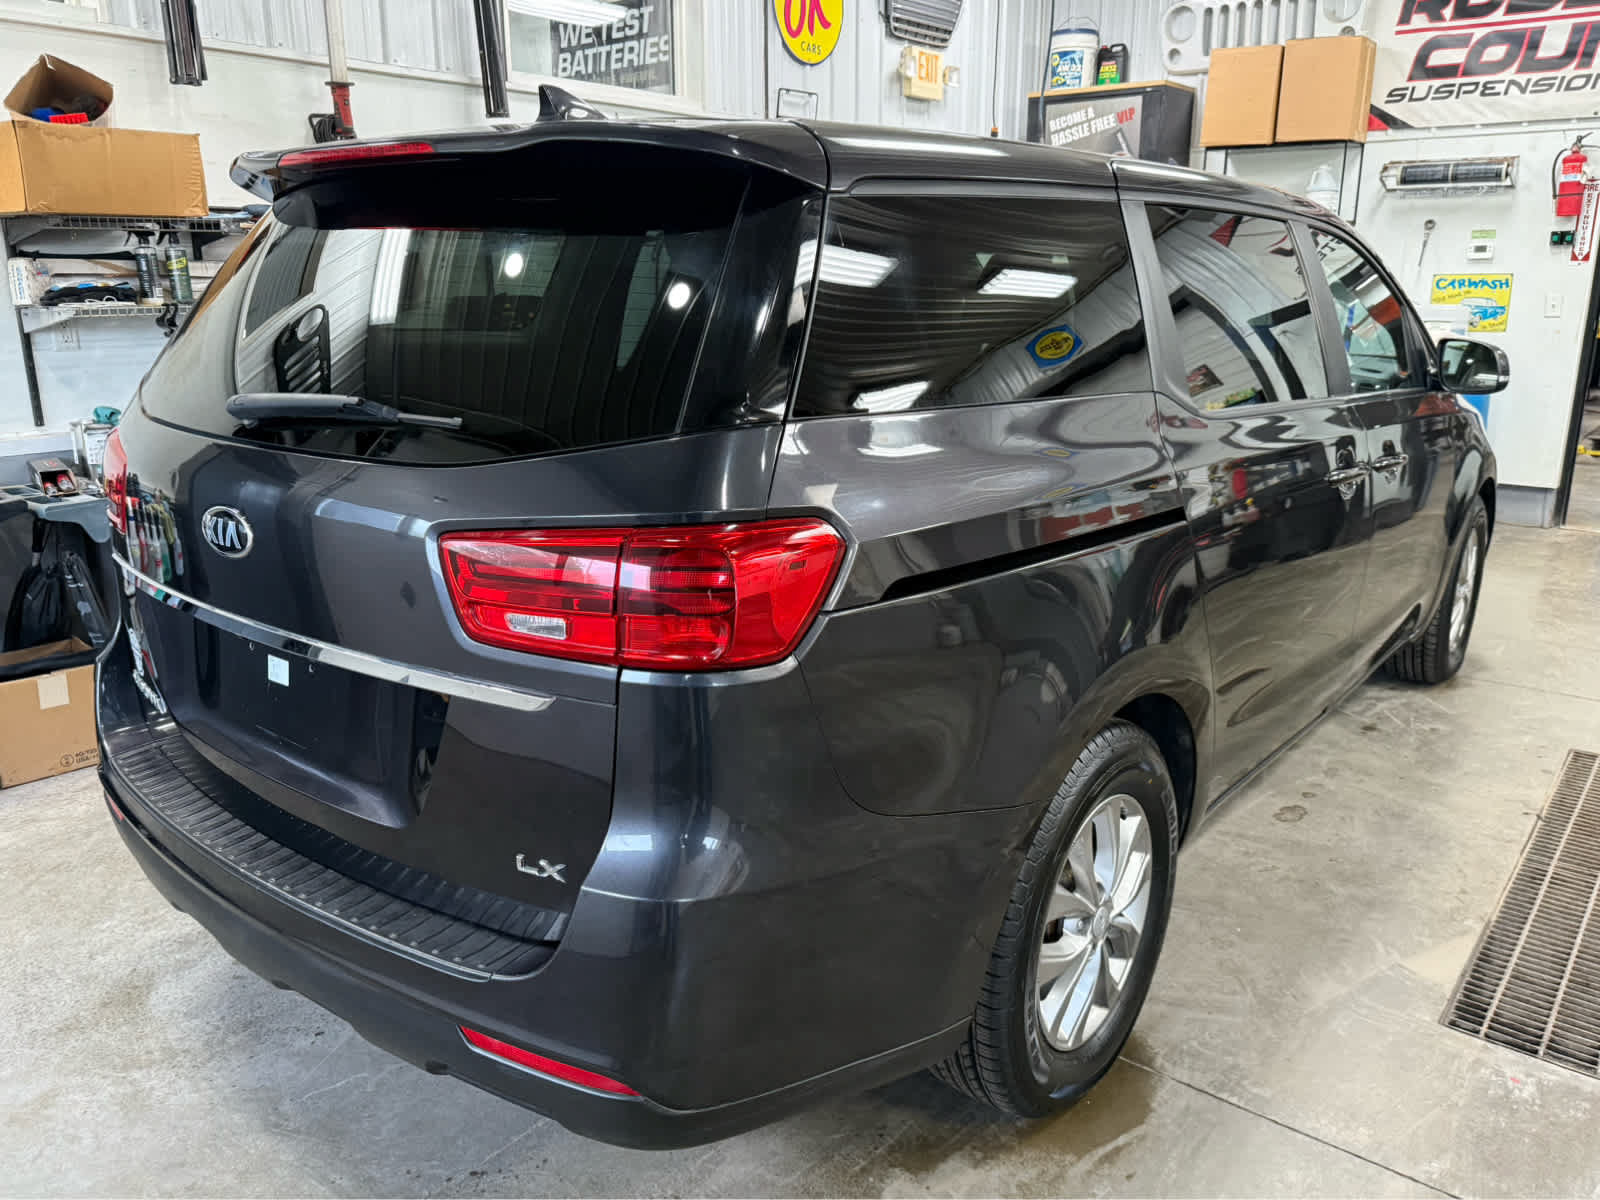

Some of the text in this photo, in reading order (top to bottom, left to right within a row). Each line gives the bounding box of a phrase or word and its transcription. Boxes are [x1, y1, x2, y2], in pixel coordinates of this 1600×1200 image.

[559, 23, 593, 48] WE
[800, 41, 822, 56] CARS
[558, 34, 670, 78] BATTERIES
[918, 51, 939, 84] EXIT
[1050, 110, 1087, 132] BECOME
[1051, 107, 1136, 146] HASSLE FREE VIP
[1584, 183, 1600, 192] FIRE
[205, 514, 242, 549] KIA
[516, 853, 567, 884] LX
